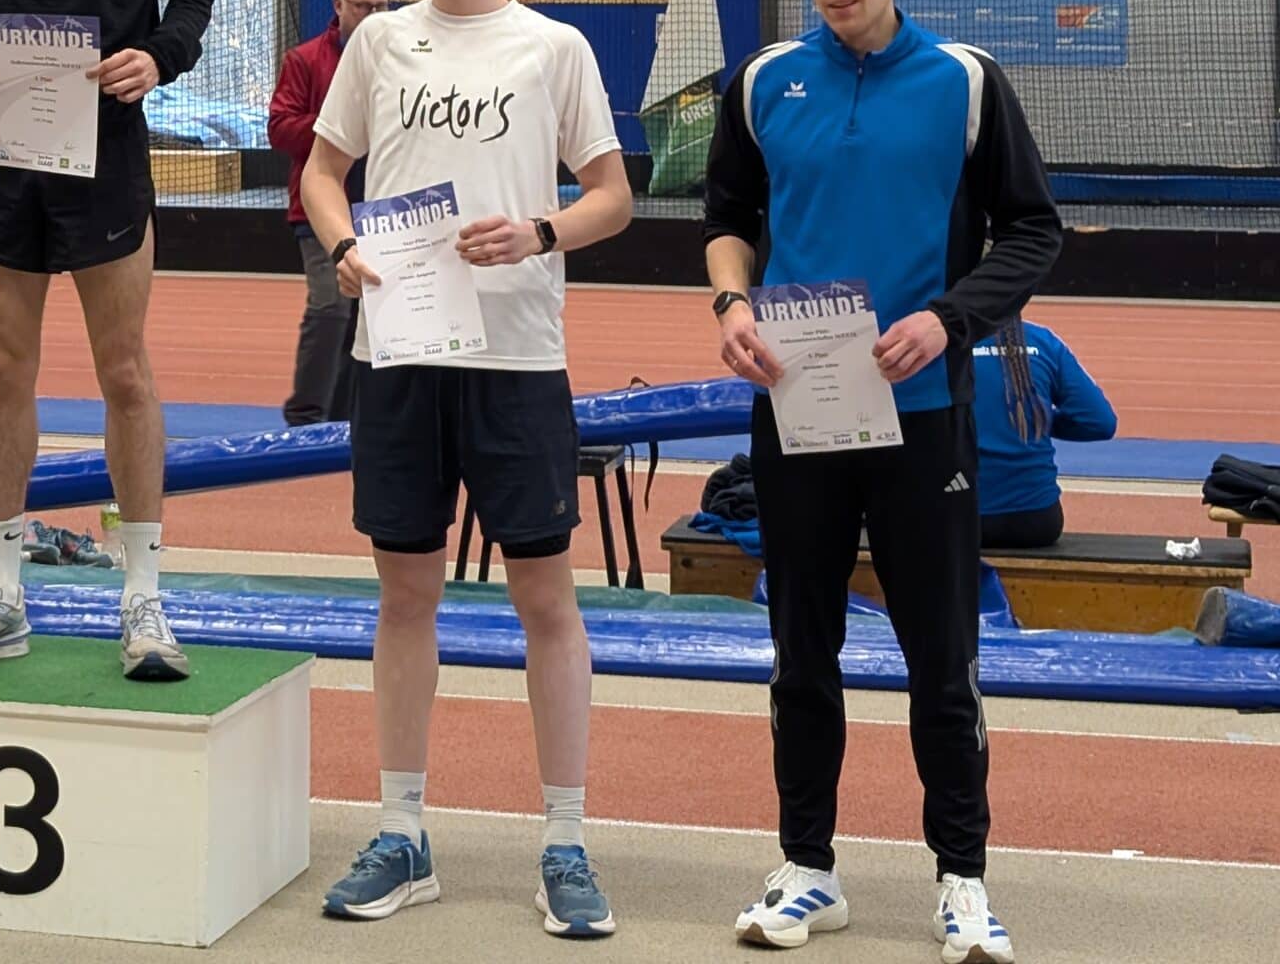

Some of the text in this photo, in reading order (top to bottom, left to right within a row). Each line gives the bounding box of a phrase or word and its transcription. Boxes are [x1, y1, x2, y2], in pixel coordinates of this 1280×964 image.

[399, 83, 515, 144] Victor's
[361, 199, 454, 237] URKUNDE
[759, 294, 867, 322] URKUNDE
